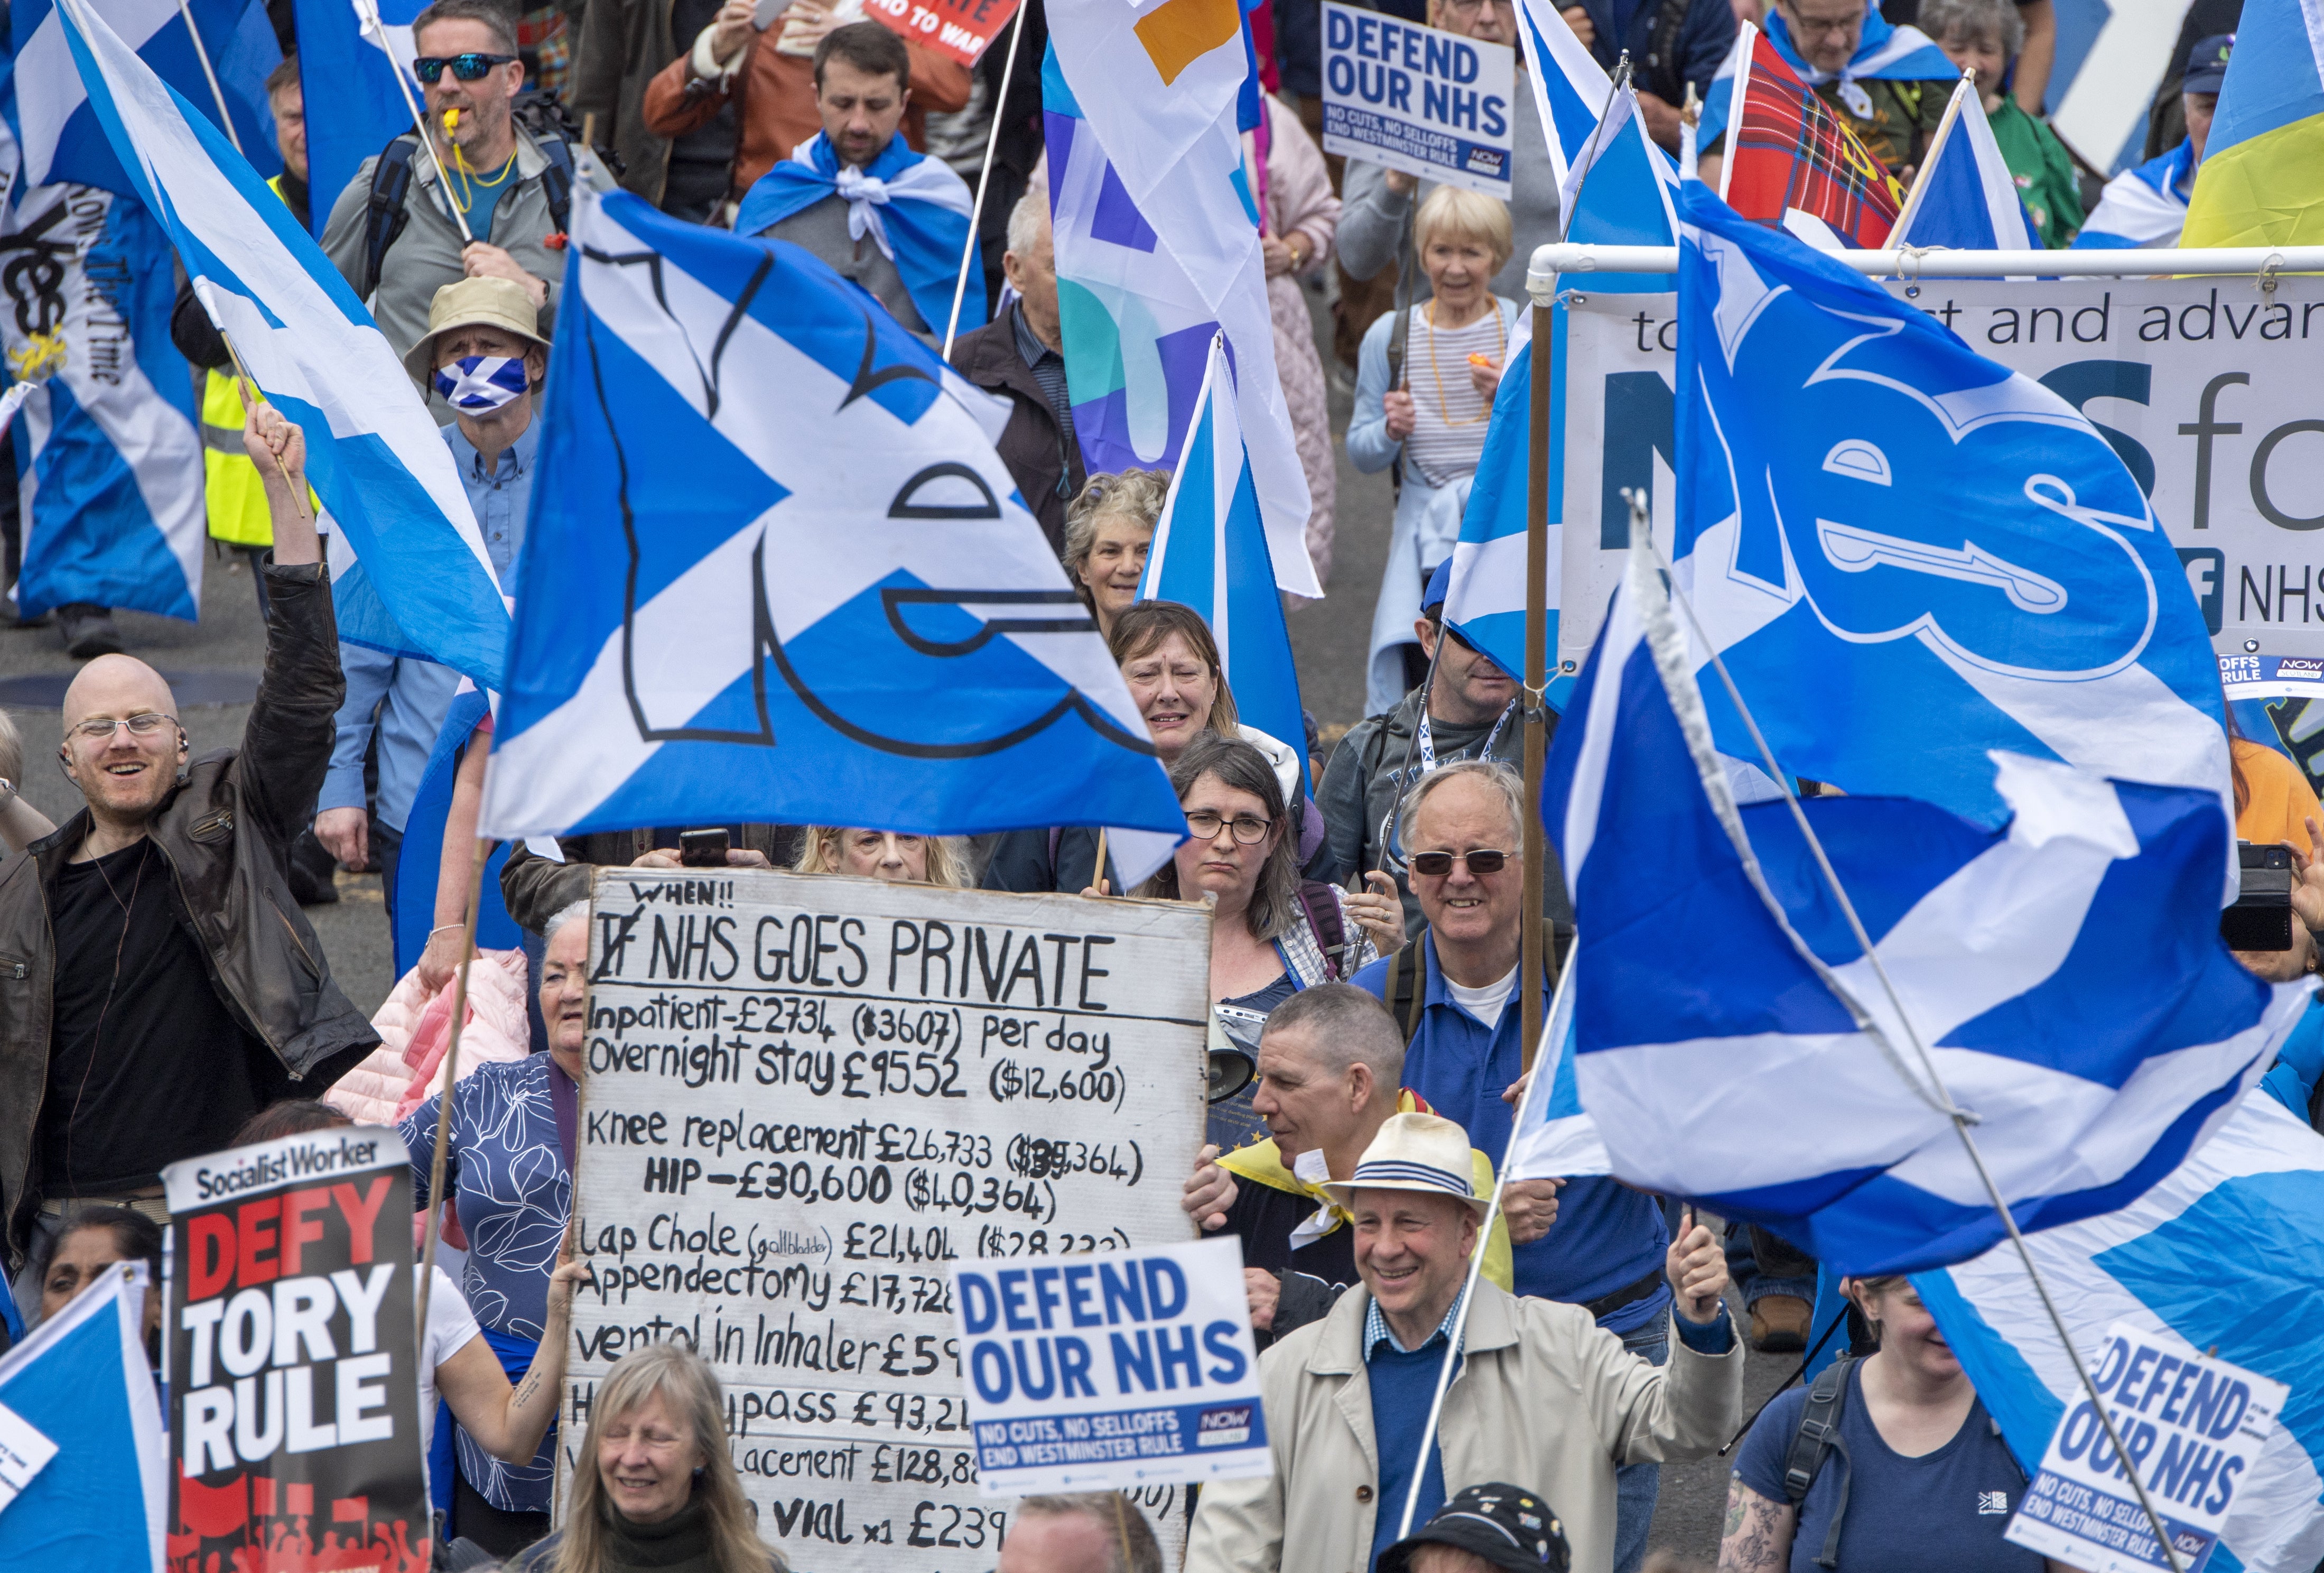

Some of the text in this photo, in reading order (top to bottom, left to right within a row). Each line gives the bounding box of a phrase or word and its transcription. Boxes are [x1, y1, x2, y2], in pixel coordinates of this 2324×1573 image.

[909, 5, 940, 33] TO
[938, 21, 986, 55] WAR
[1327, 9, 1480, 85] DEFEND
[1327, 54, 1508, 137] OUR NHS
[1327, 106, 1345, 121] NO
[1384, 119, 1401, 136] NO
[1403, 125, 1458, 154] SELLOFFS
[1327, 121, 1351, 134] END
[1352, 125, 1427, 158] WESTMINSTER
[1429, 147, 1458, 168] RULE
[1471, 148, 1504, 165] NOW
[0, 197, 78, 340] Yes
[1987, 292, 2111, 345] and
[1693, 245, 2159, 683] Yes
[2219, 656, 2261, 671] OFFS
[2221, 669, 2262, 683] RULE
[2281, 660, 2323, 670] NOW
[629, 880, 735, 909] WHEN!!
[648, 913, 740, 982] NHS
[754, 913, 869, 988] GOES
[888, 919, 1117, 1011] PRIVATE
[980, 1015, 1040, 1059] per
[1045, 1013, 1111, 1071] day
[589, 1033, 753, 1088] Overnight
[842, 1049, 968, 1099] £9552
[989, 1057, 1126, 1115] ($12,600)
[196, 1135, 379, 1201] Socialist Worker
[905, 1165, 1057, 1225] ($40,364)
[187, 1175, 395, 1302] DEFY
[580, 1217, 637, 1264] Lap
[648, 1211, 742, 1257] Chole
[747, 1222, 833, 1266] (gallbladder)
[577, 1254, 832, 1312] Appendectomy
[957, 1256, 1189, 1335] DEFEND
[181, 1262, 396, 1390] TORY
[755, 1312, 879, 1374] Inhaler
[970, 1319, 1248, 1404] OUR NHS
[2084, 1336, 2251, 1441] DEFEND
[183, 1353, 395, 1479] RULE
[979, 1410, 1180, 1445] NO CUTS, NO SELLOFFS
[1200, 1409, 1250, 1429] NOW
[983, 1445, 1018, 1468] END
[1020, 1437, 1139, 1464] WESTMINSTER
[1140, 1433, 1186, 1455] RULE
[2059, 1400, 2158, 1483] OUR
[2147, 1432, 2245, 1516] NHS
[2034, 1473, 2058, 1497] NO
[2093, 1495, 2114, 1517] NO
[2024, 1495, 2052, 1519] END
[2051, 1504, 2128, 1549] WESTMINSTER
[2125, 1533, 2160, 1561] RULE
[2174, 1533, 2206, 1553] NOW
